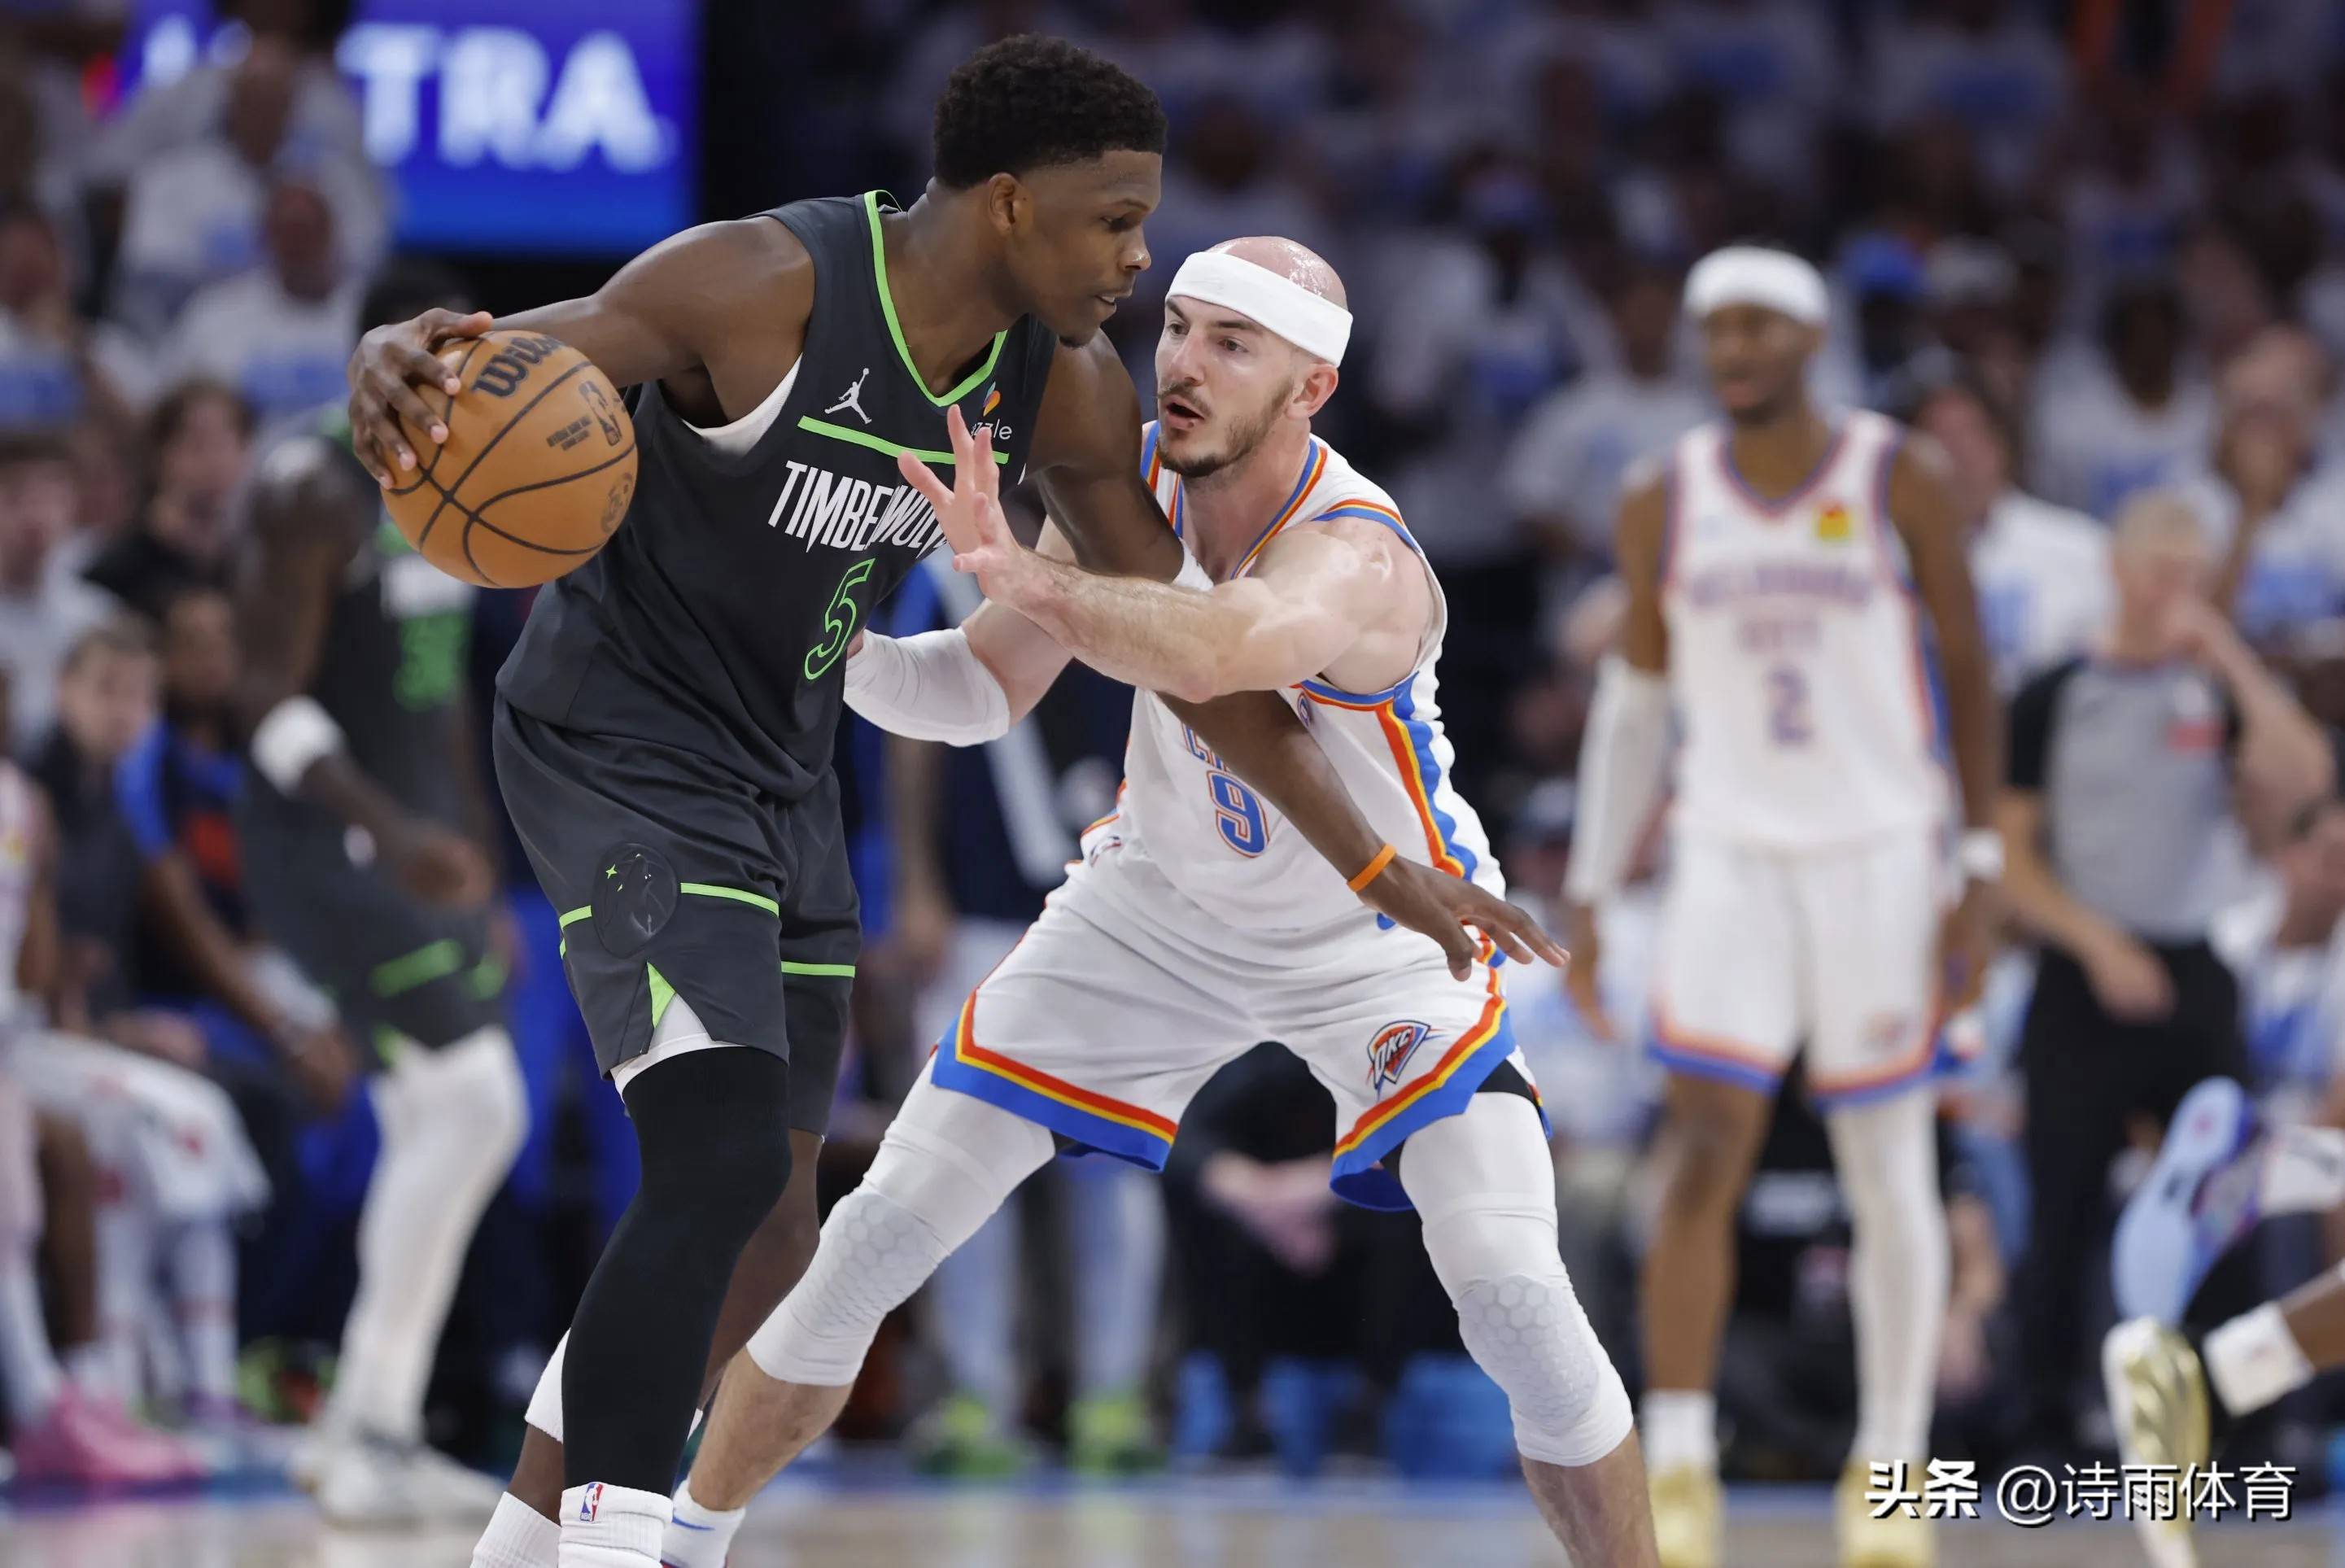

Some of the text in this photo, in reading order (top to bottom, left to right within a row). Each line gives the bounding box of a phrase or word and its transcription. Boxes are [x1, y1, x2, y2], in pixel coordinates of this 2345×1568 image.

[142, 16, 666, 173] TRA
[804, 557, 876, 680] 5
[1767, 666, 1814, 747] 2
[1206, 769, 1271, 859] 9
[1373, 1027, 1412, 1088] OKC
